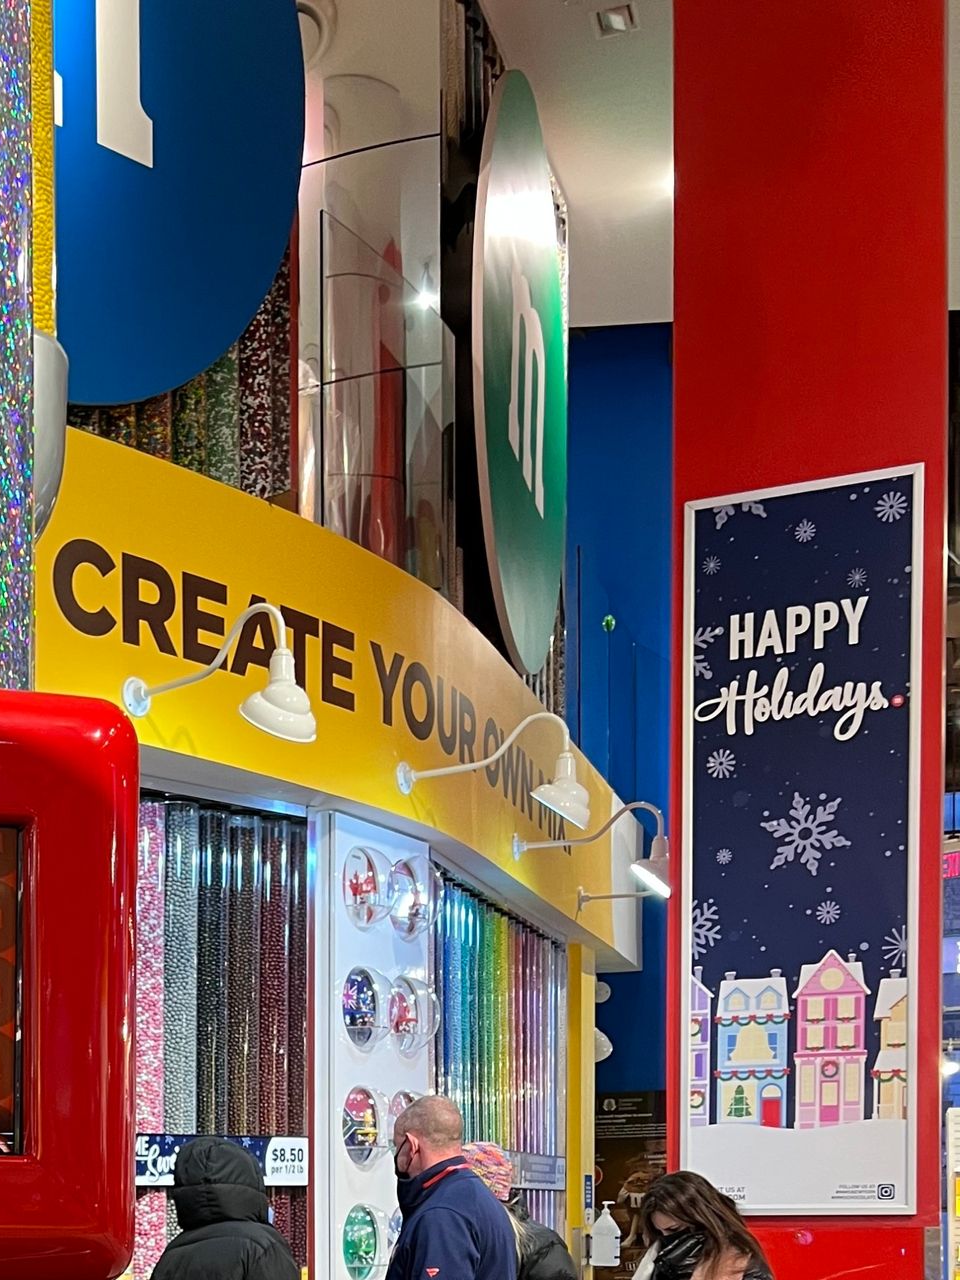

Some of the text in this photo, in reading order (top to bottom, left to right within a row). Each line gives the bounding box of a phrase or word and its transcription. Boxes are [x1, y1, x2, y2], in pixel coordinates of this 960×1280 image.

[729, 596, 869, 661] HAPPY
[52, 537, 356, 712] CREATE
[369, 639, 477, 773] YOUR
[483, 716, 534, 822] OWN
[271, 1164, 304, 1175] per 1/2 lb
[272, 1147, 304, 1163] $8.50
